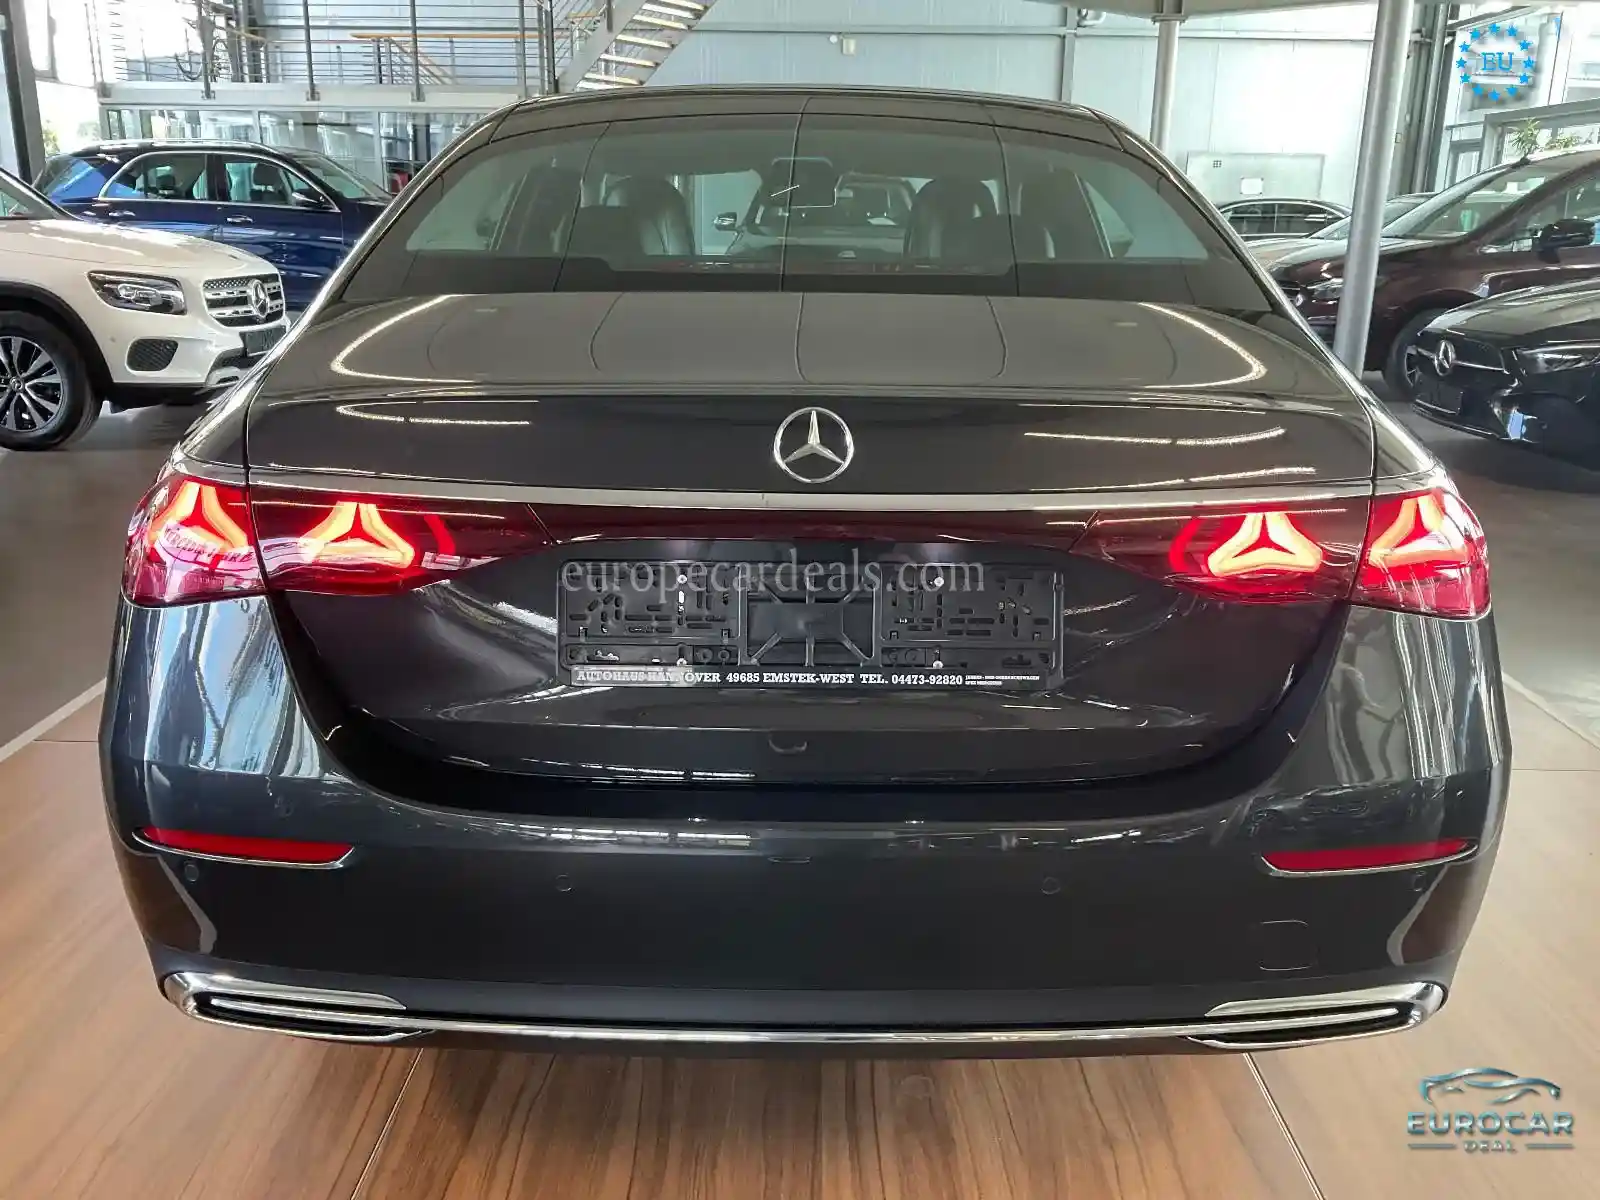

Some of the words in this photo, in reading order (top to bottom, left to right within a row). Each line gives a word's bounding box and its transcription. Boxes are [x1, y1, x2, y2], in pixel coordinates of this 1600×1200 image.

[576, 671, 645, 682] AUTOHAUS
[726, 672, 760, 683] 49685
[763, 672, 855, 684] EMSTEK-WEST
[860, 673, 889, 684] TEL.
[891, 673, 963, 685] 04473-92820
